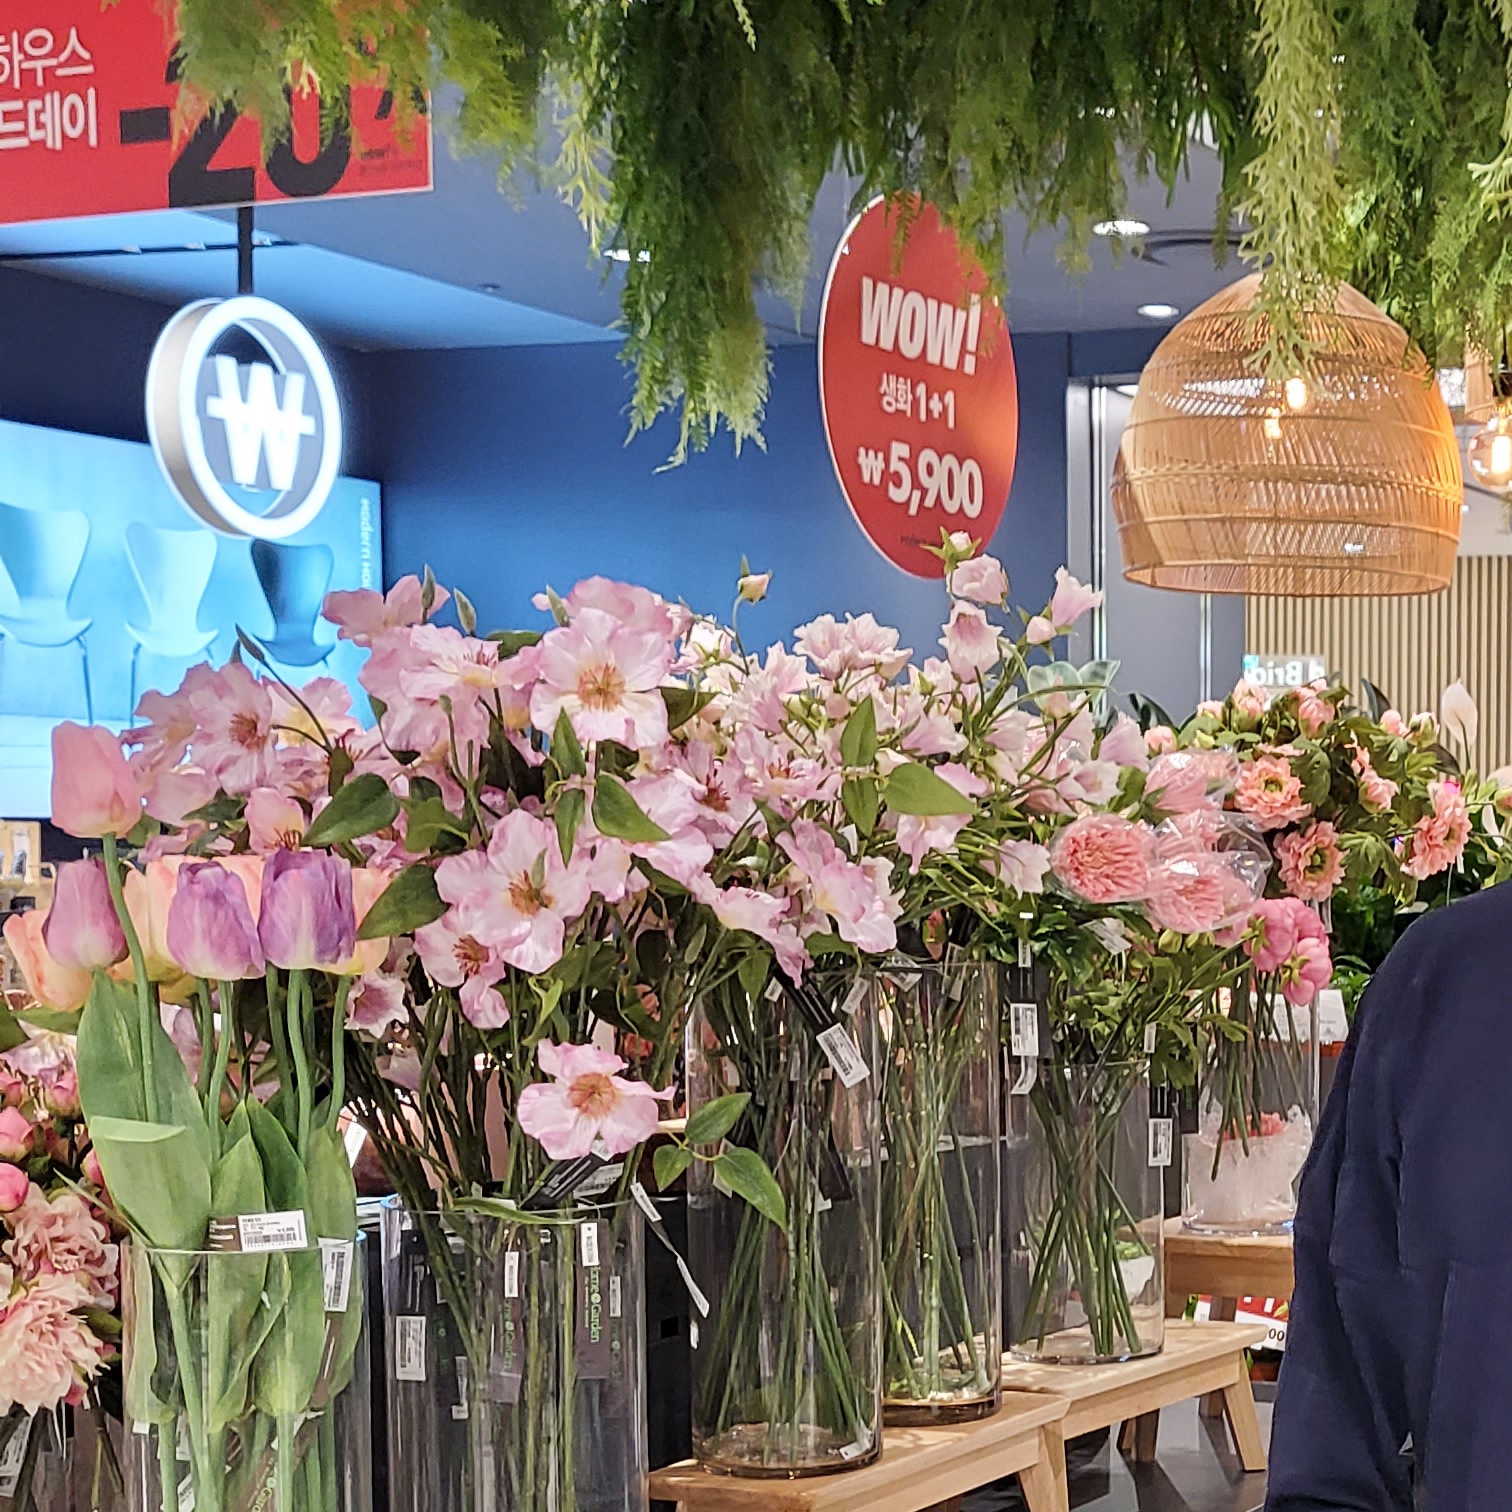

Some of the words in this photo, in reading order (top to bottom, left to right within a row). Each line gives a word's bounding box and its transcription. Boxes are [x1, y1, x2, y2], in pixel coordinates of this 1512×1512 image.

[0, 26, 95, 90] 하우스
[0, 86, 98, 151] 드데이
[860, 275, 982, 376] WOW!
[878, 372, 913, 418] 생화
[915, 381, 956, 429] 1+1
